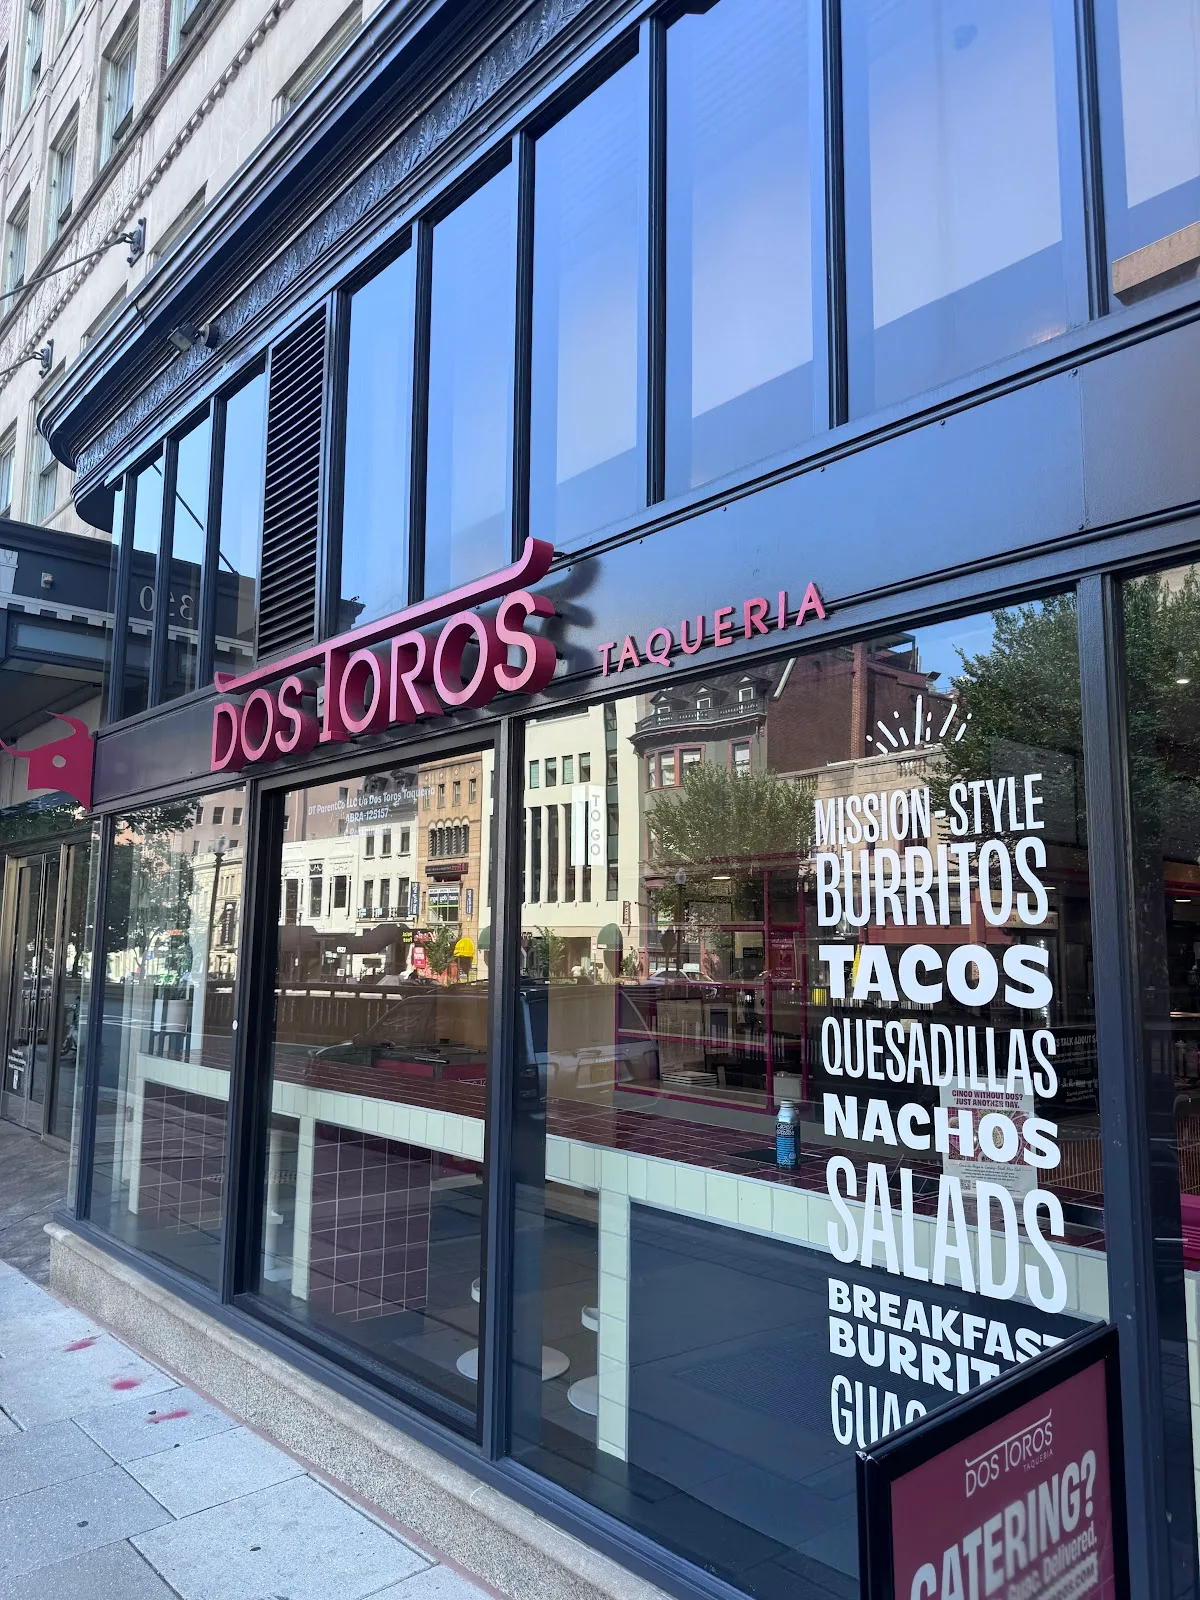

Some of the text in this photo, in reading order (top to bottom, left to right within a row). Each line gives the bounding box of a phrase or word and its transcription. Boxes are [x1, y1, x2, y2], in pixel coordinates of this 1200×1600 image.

[211, 581, 826, 773] DOS TOROS TAQUERIA
[308, 806, 317, 816] DT
[317, 800, 346, 814] ParentCo
[346, 797, 358, 809] LLC
[369, 794, 382, 805] Dos
[383, 791, 402, 803] Toros
[402, 785, 436, 802] Taqueria
[345, 807, 389, 823] ABRA-125157
[590, 794, 601, 856] TO GO
[816, 836, 1049, 927] BURRITOS
[818, 944, 1054, 1009] TACOS
[821, 1016, 1058, 1098] QUESADILLAS
[951, 1089, 1024, 1101] CINCO WITHOUT DOS?
[956, 1098, 1020, 1109] JUST ANOTHER DAY.
[823, 1092, 1061, 1170] NACHOS
[826, 1155, 1068, 1314] SALADS
[828, 1315, 1003, 1395] BURRIT
[965, 1417, 1053, 1498] DOS TOROS
[1022, 1448, 1054, 1473] TAQUERIA
[1043, 1519, 1098, 1584] Delivered.
